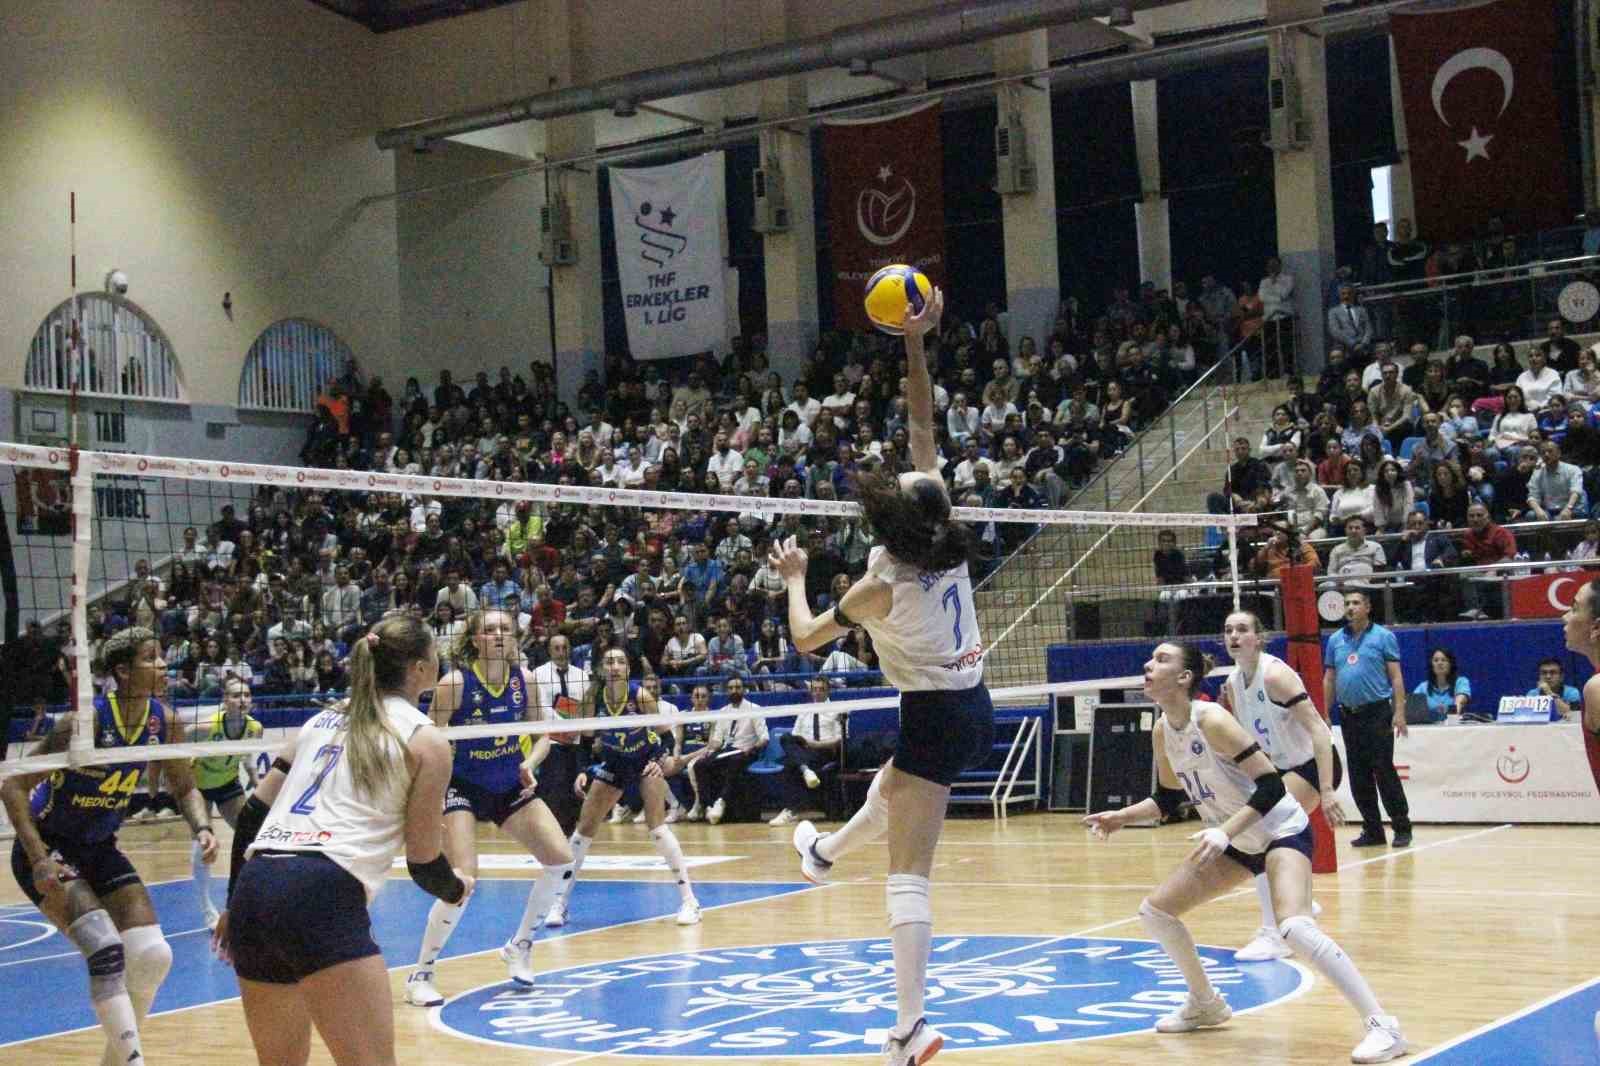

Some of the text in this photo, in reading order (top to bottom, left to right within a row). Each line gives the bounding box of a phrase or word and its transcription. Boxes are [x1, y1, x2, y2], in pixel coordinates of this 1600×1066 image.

[648, 272, 676, 289] THF
[626, 284, 710, 309] ERKEKLER
[942, 583, 962, 651] 7
[99, 768, 140, 796] 44
[289, 743, 344, 816] 2
